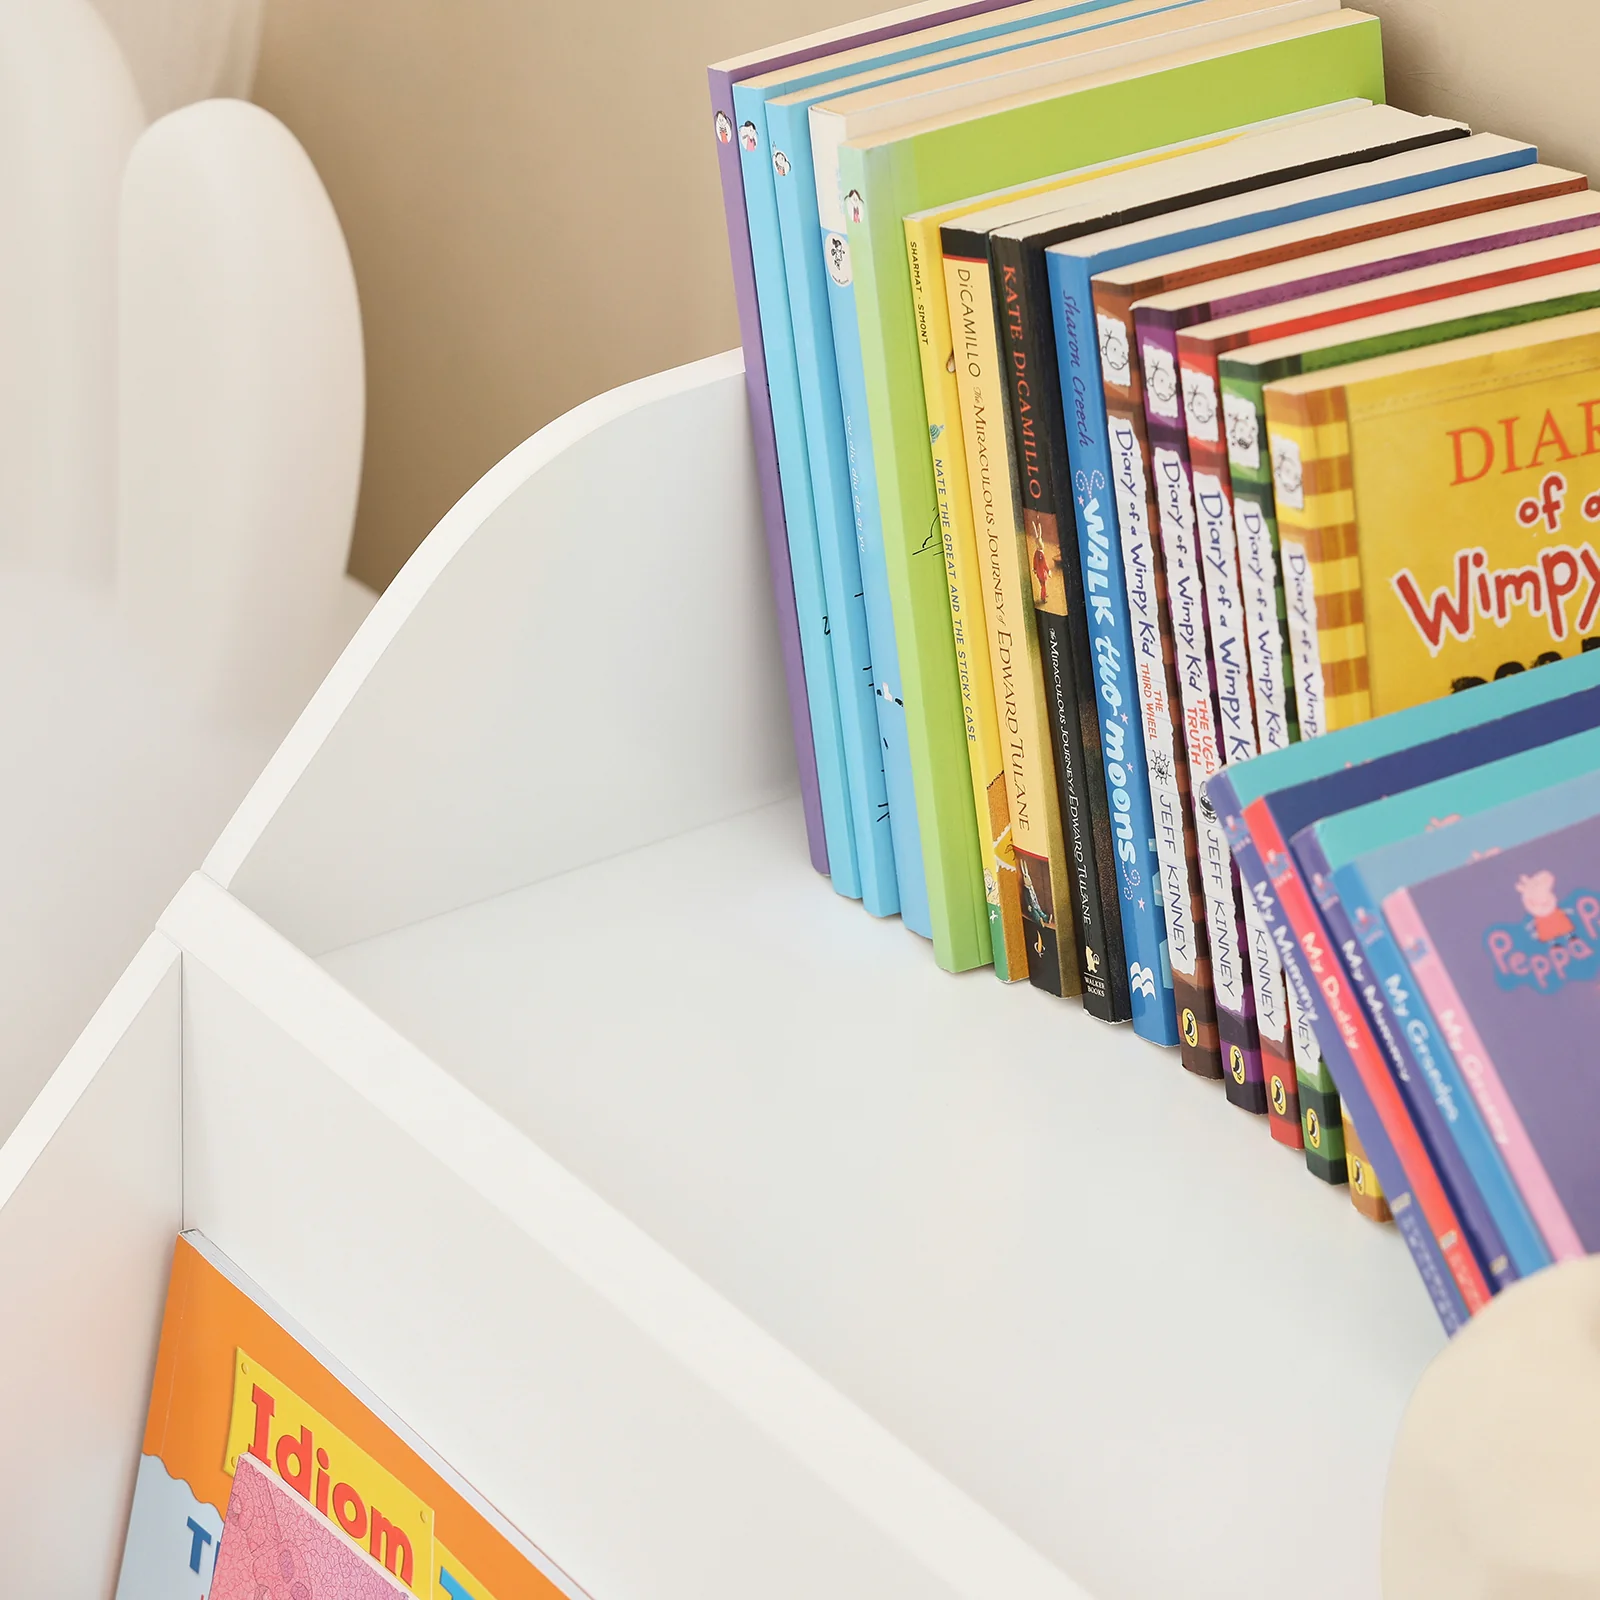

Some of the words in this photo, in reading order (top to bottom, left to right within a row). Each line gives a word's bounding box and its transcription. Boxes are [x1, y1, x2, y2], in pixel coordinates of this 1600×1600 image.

[910, 241, 923, 294] SHARMAT
[917, 303, 929, 346] SIMONT
[957, 268, 981, 378] DiCAMILLO
[1003, 265, 1024, 340] KATE
[1063, 290, 1081, 368] Sharon
[1072, 376, 1095, 447] Creech
[935, 459, 947, 496] NATE
[1115, 429, 1138, 497] Diary
[940, 502, 951, 528] THE
[1128, 502, 1140, 523] of
[1163, 461, 1185, 530] Diary
[1517, 472, 1566, 532] of
[943, 533, 957, 579] GREAT
[1130, 525, 1138, 536] a
[1176, 534, 1188, 555] of
[1199, 491, 1229, 579] Diary
[1243, 513, 1264, 582] Diary
[1083, 497, 1115, 627] WALK
[1130, 543, 1148, 617] Wimpy
[1178, 558, 1185, 569] a
[950, 584, 960, 613] AND
[973, 404, 995, 526] MIRACULOUS
[986, 528, 1006, 618] JOURNEY
[997, 630, 1019, 735] EDWARD
[1010, 738, 1030, 832] TULANE
[1177, 576, 1195, 650] Wimpy
[1217, 584, 1232, 609] of
[1220, 614, 1228, 628] a
[1257, 587, 1268, 608] of
[1258, 612, 1265, 623] a
[1288, 553, 1309, 624] Diary
[1302, 630, 1312, 651] of
[954, 619, 965, 646] THE
[1138, 620, 1156, 659] Kid
[957, 651, 972, 702] STICKY
[1095, 635, 1123, 717] two
[1185, 653, 1203, 693] Kid
[1219, 636, 1241, 730] Wimpy
[1257, 630, 1274, 705] Wimpy
[964, 706, 977, 742] CASE
[1140, 663, 1152, 699] THIRD
[1146, 702, 1157, 741] WHEEL
[1152, 690, 1164, 713] THE
[1196, 699, 1209, 731] THE
[1264, 709, 1283, 749] Kid
[1187, 707, 1201, 766] TRUTH
[1202, 735, 1215, 775] UGLY
[1049, 639, 1067, 726] MIRACULOUS
[1060, 725, 1076, 787] JOURNEY
[1069, 794, 1084, 863] EDWARD
[1077, 864, 1093, 926] TULANE
[1105, 719, 1137, 866] moons
[1160, 794, 1177, 854] JEFF
[1207, 829, 1224, 890] JEFF
[1167, 864, 1188, 961] KINNEY
[1575, 895, 1600, 941] P
[1213, 900, 1235, 998] KINNEY
[1252, 880, 1275, 923] My
[1273, 925, 1320, 1022] Mummy
[1254, 928, 1276, 1028] KINNEY
[1301, 931, 1325, 974] My
[1342, 939, 1366, 983] My
[1487, 930, 1594, 989] Peppa
[1084, 976, 1106, 990] WALKER
[1087, 985, 1106, 998] BOOKS
[1385, 973, 1410, 1018] My
[248, 1382, 414, 1588] Idiom
[186, 1515, 222, 1576] T
